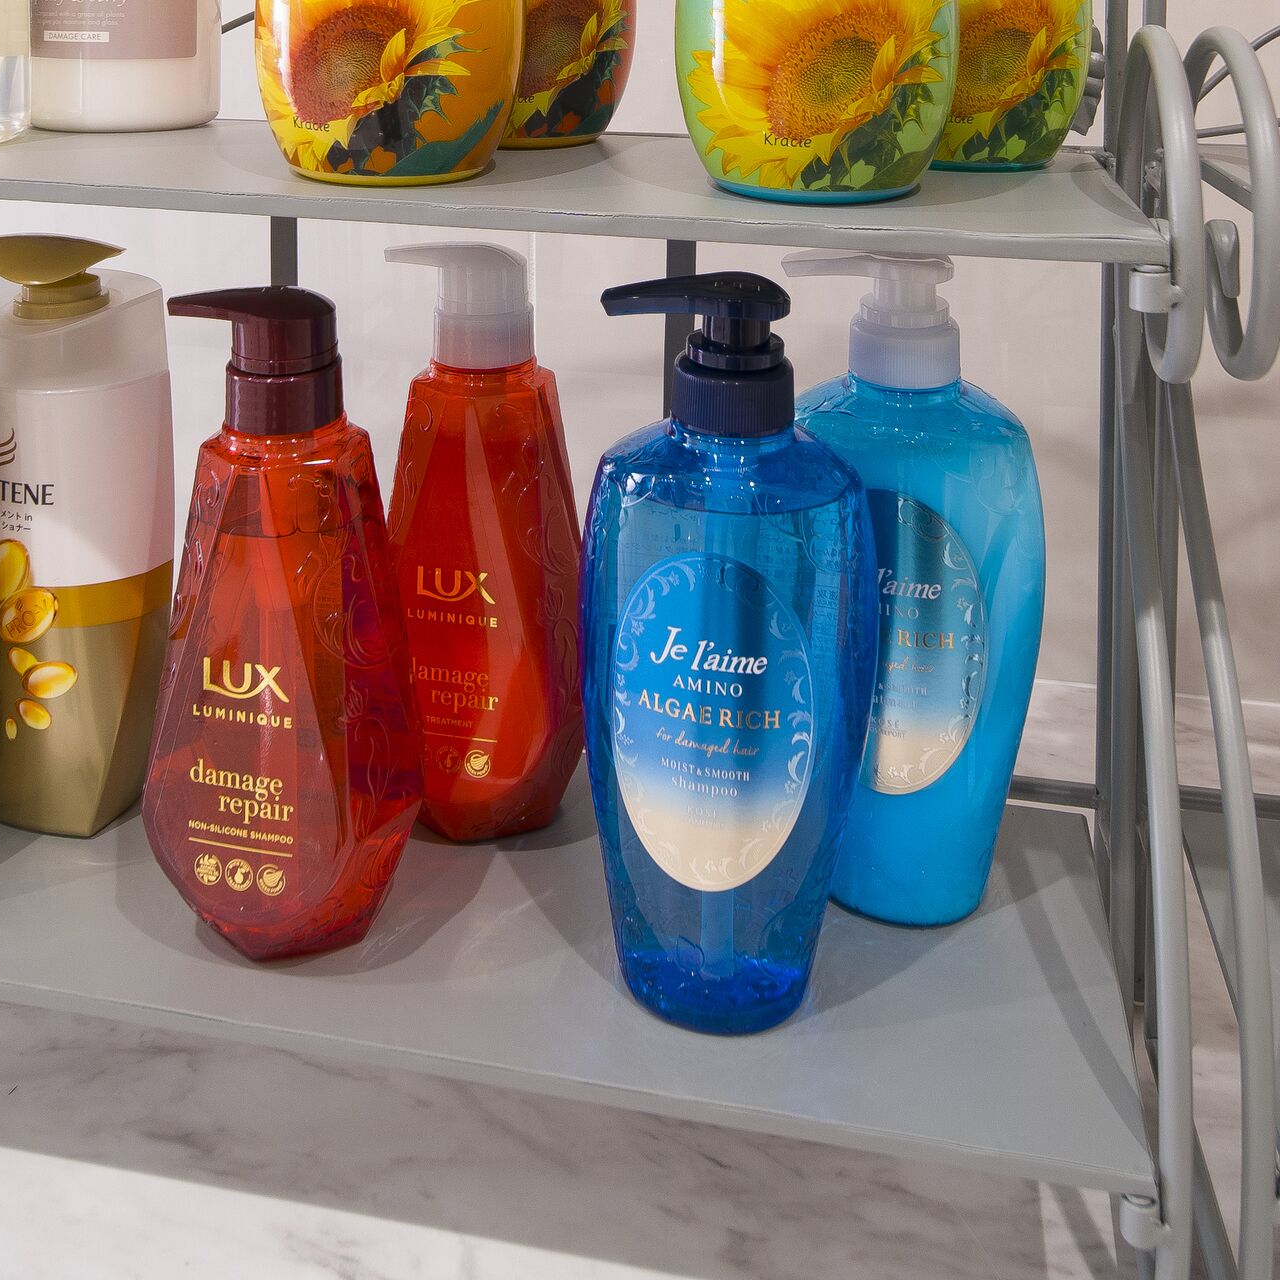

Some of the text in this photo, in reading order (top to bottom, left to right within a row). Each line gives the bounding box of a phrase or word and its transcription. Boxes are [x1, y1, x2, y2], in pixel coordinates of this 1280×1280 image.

[48, 32, 101, 41] DAMAGE CARE
[24, 513, 33, 522] in
[417, 566, 496, 605] LUX
[407, 608, 498, 628] LUMINIQUE
[650, 626, 768, 676] Je l'aime
[897, 629, 954, 650] RICH
[202, 656, 290, 704] LUX
[673, 674, 743, 698] AMINO
[431, 688, 499, 713] repair
[638, 689, 781, 730] ALGAE RICH
[192, 704, 293, 729] LUMINIQUE
[656, 726, 760, 759] for damaged hair
[189, 758, 283, 802] damage
[661, 756, 750, 782] MOIST & SMOOTH
[671, 775, 738, 798] shampoo
[218, 794, 294, 825] repair
[188, 819, 294, 845] NON-SILICONE SHAMPOO
